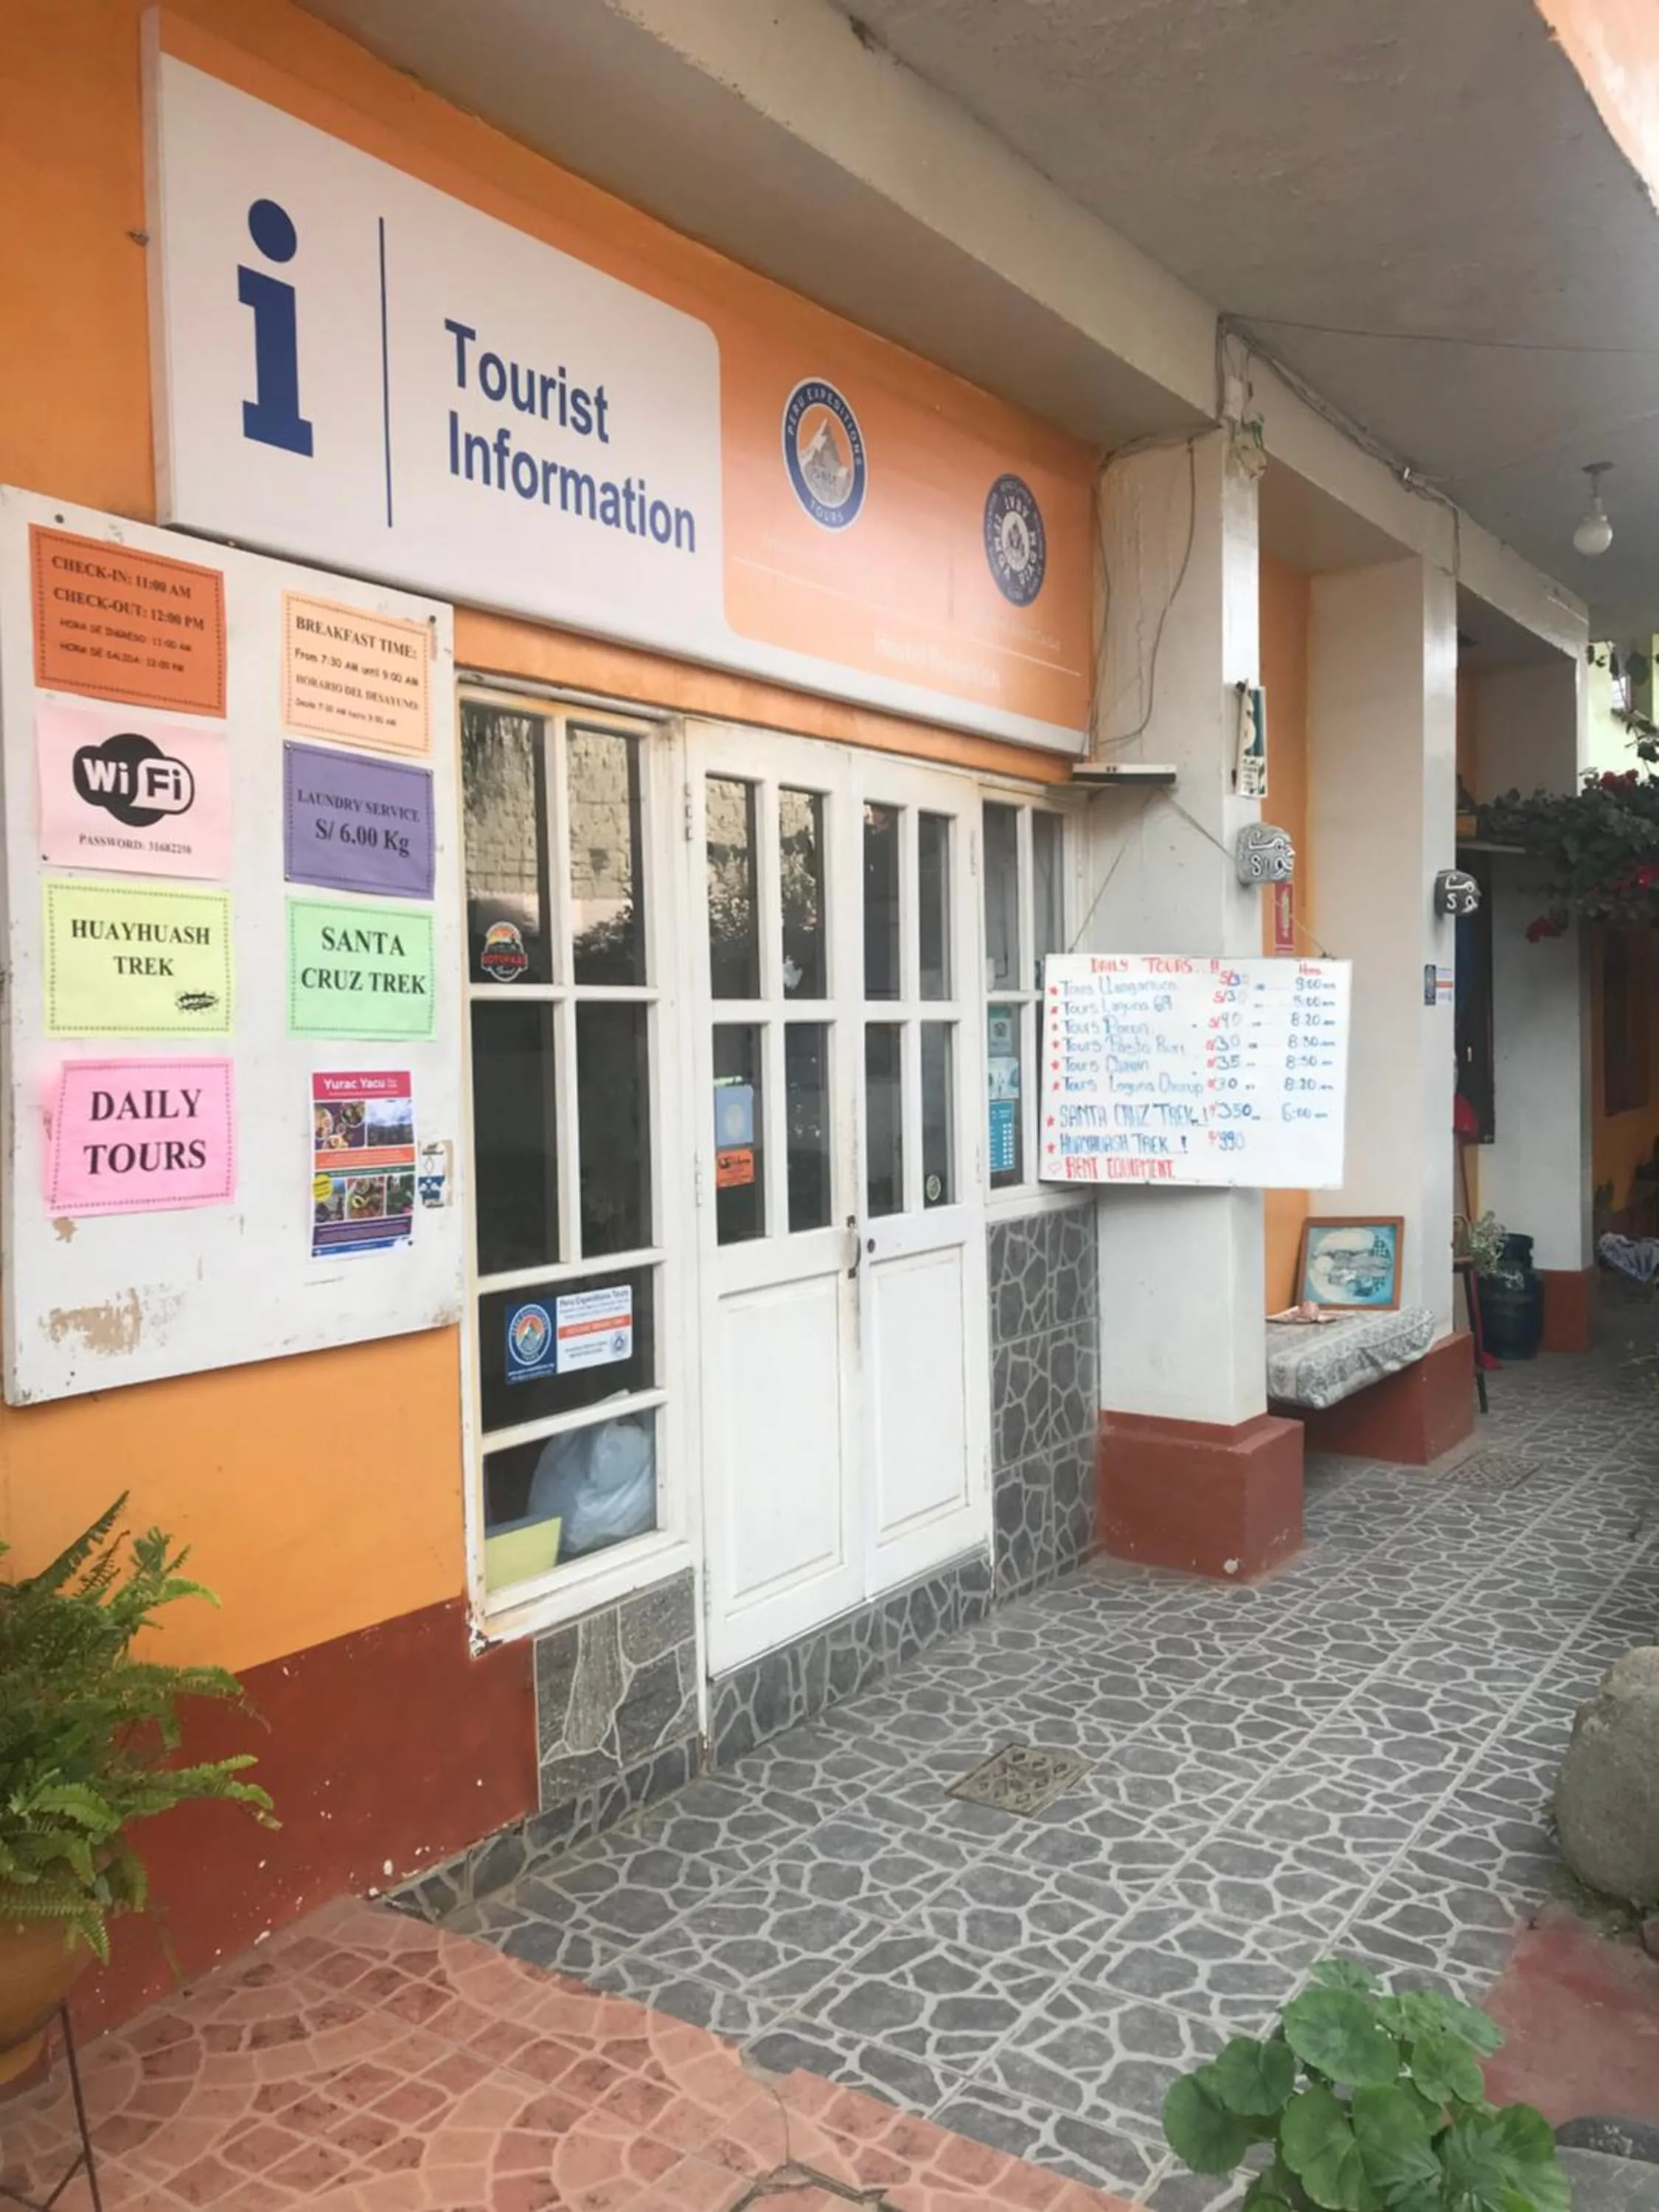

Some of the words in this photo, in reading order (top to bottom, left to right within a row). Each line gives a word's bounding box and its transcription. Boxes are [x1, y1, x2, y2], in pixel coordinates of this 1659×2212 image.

[445, 318, 609, 444] Tourist
[449, 409, 695, 554] Information
[52, 555, 133, 585] CHECK-IN:
[136, 575, 167, 592] 11:00
[169, 584, 192, 599] AM
[53, 587, 147, 618] CHECK-OUT:
[151, 609, 181, 626] 12:00
[184, 616, 205, 631] PM
[90, 624, 102, 635] DE
[296, 616, 376, 649] BREAKFAST
[379, 636, 417, 660] TIME:
[295, 647, 319, 662] From
[345, 662, 359, 672] AM
[405, 675, 419, 686] AM
[296, 674, 343, 693] HORARIO
[344, 684, 363, 699] DEL
[297, 788, 363, 812] LAUNDRY
[366, 801, 421, 822] SERVICE
[79, 833, 145, 851] PASSWORD:
[316, 818, 335, 840] S/
[340, 823, 378, 846] 6.00
[383, 829, 410, 858] Kg
[71, 919, 210, 945] HUAYHUASH
[321, 926, 406, 957] SANTA
[113, 956, 175, 976] TREK
[301, 967, 364, 991] CRUZ
[369, 972, 427, 995] TREK
[89, 1089, 201, 1121] DAILY
[83, 1139, 206, 1175] TOURS
